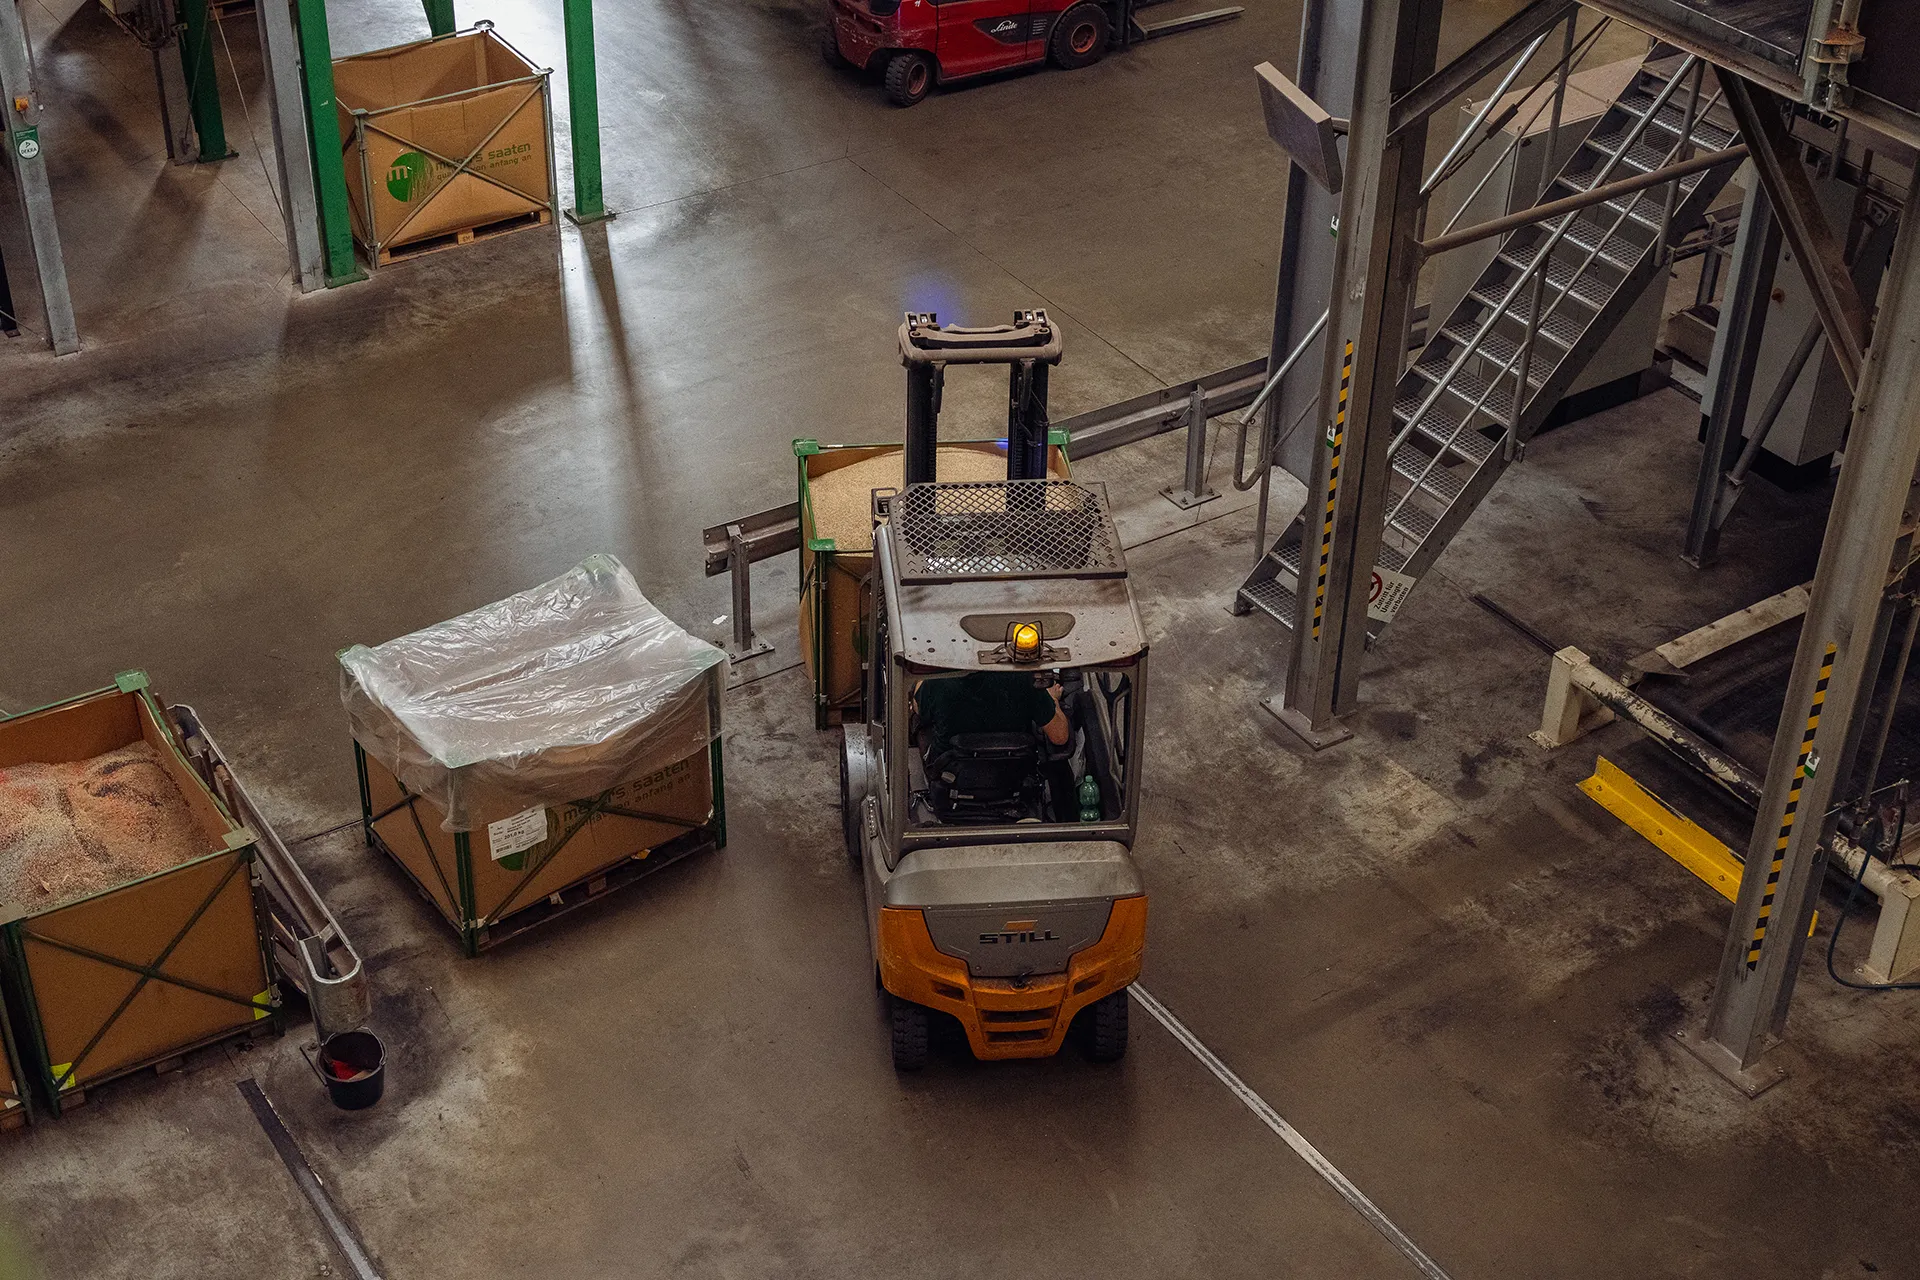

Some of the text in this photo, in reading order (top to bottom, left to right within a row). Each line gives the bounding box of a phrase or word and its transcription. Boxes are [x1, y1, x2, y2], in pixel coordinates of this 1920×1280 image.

[990, 19, 1018, 33] Linde
[487, 143, 531, 161] saaten
[1373, 581, 1395, 610] Zutritt für
[1380, 582, 1403, 613] Unbefugte
[1390, 586, 1409, 613] verboten
[632, 759, 690, 792] saaten
[979, 929, 1060, 944] STILL
